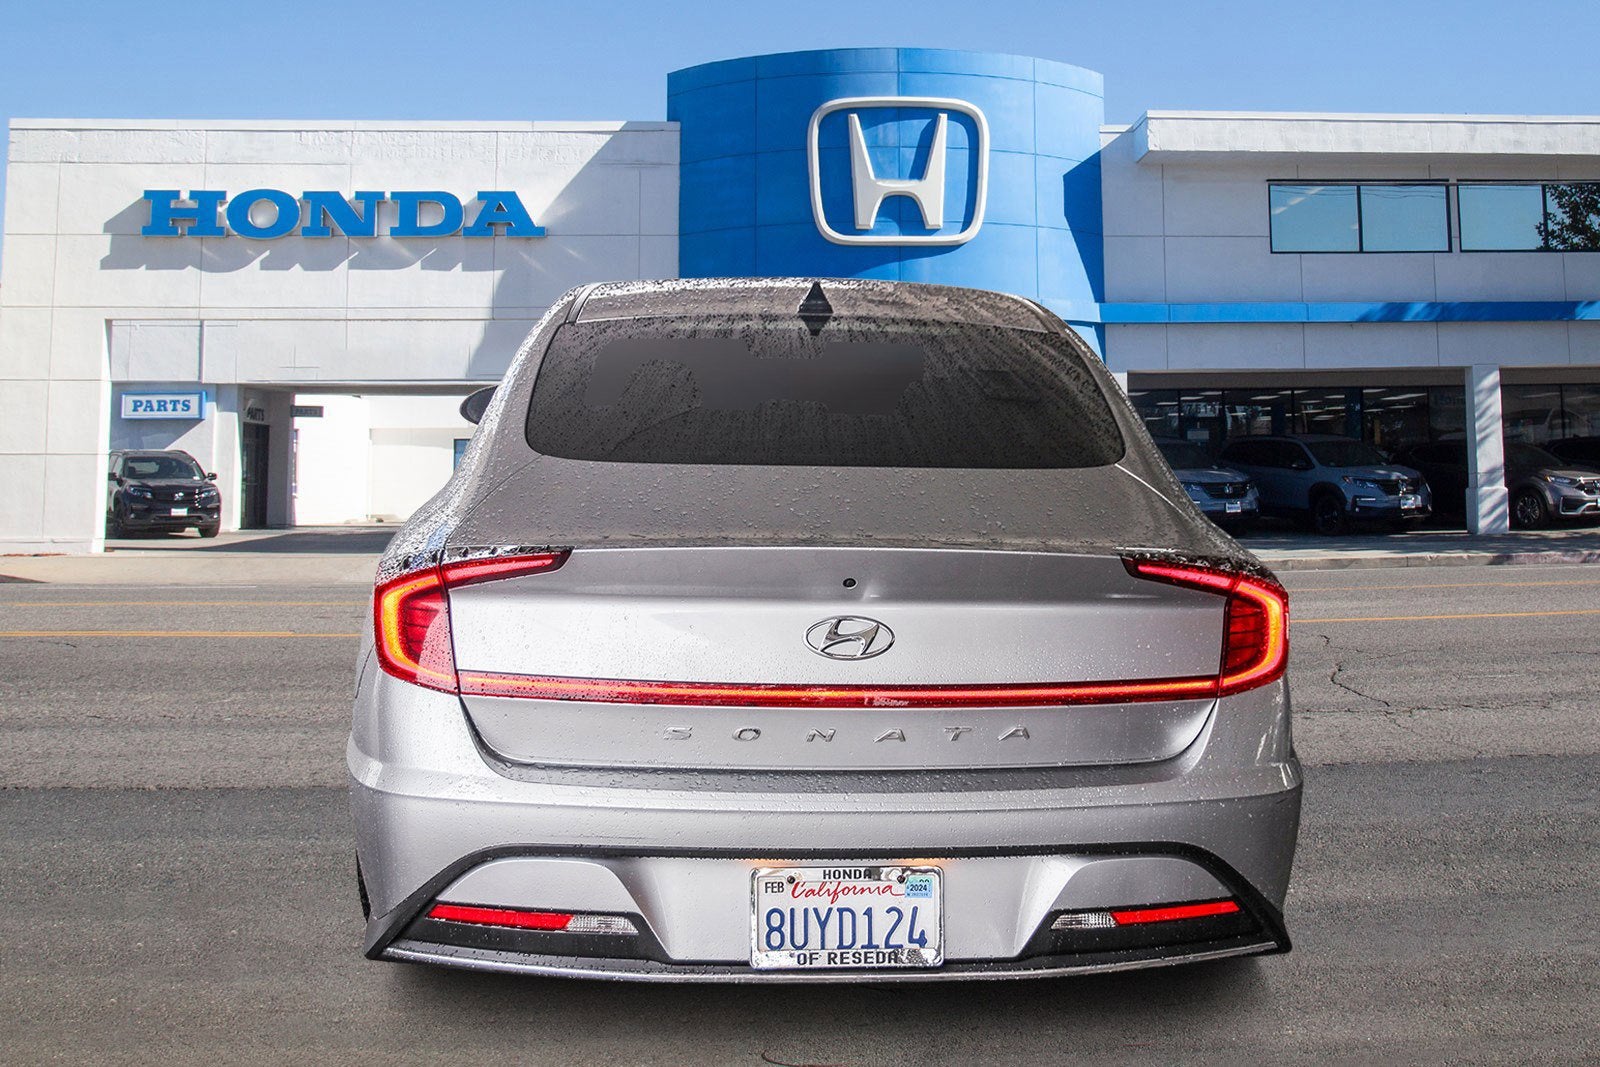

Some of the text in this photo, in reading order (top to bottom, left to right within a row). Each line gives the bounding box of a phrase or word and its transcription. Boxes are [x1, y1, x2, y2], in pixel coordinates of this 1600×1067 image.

[141, 189, 548, 239] HONDA
[132, 399, 191, 412] PARTS
[663, 726, 1030, 743] SONATA
[822, 869, 872, 880] HONDA
[764, 881, 785, 894] FEB
[791, 881, 906, 905] California
[910, 884, 928, 892] 2024
[765, 905, 928, 951] 8UYD124
[796, 950, 901, 966] OF RESEDA
